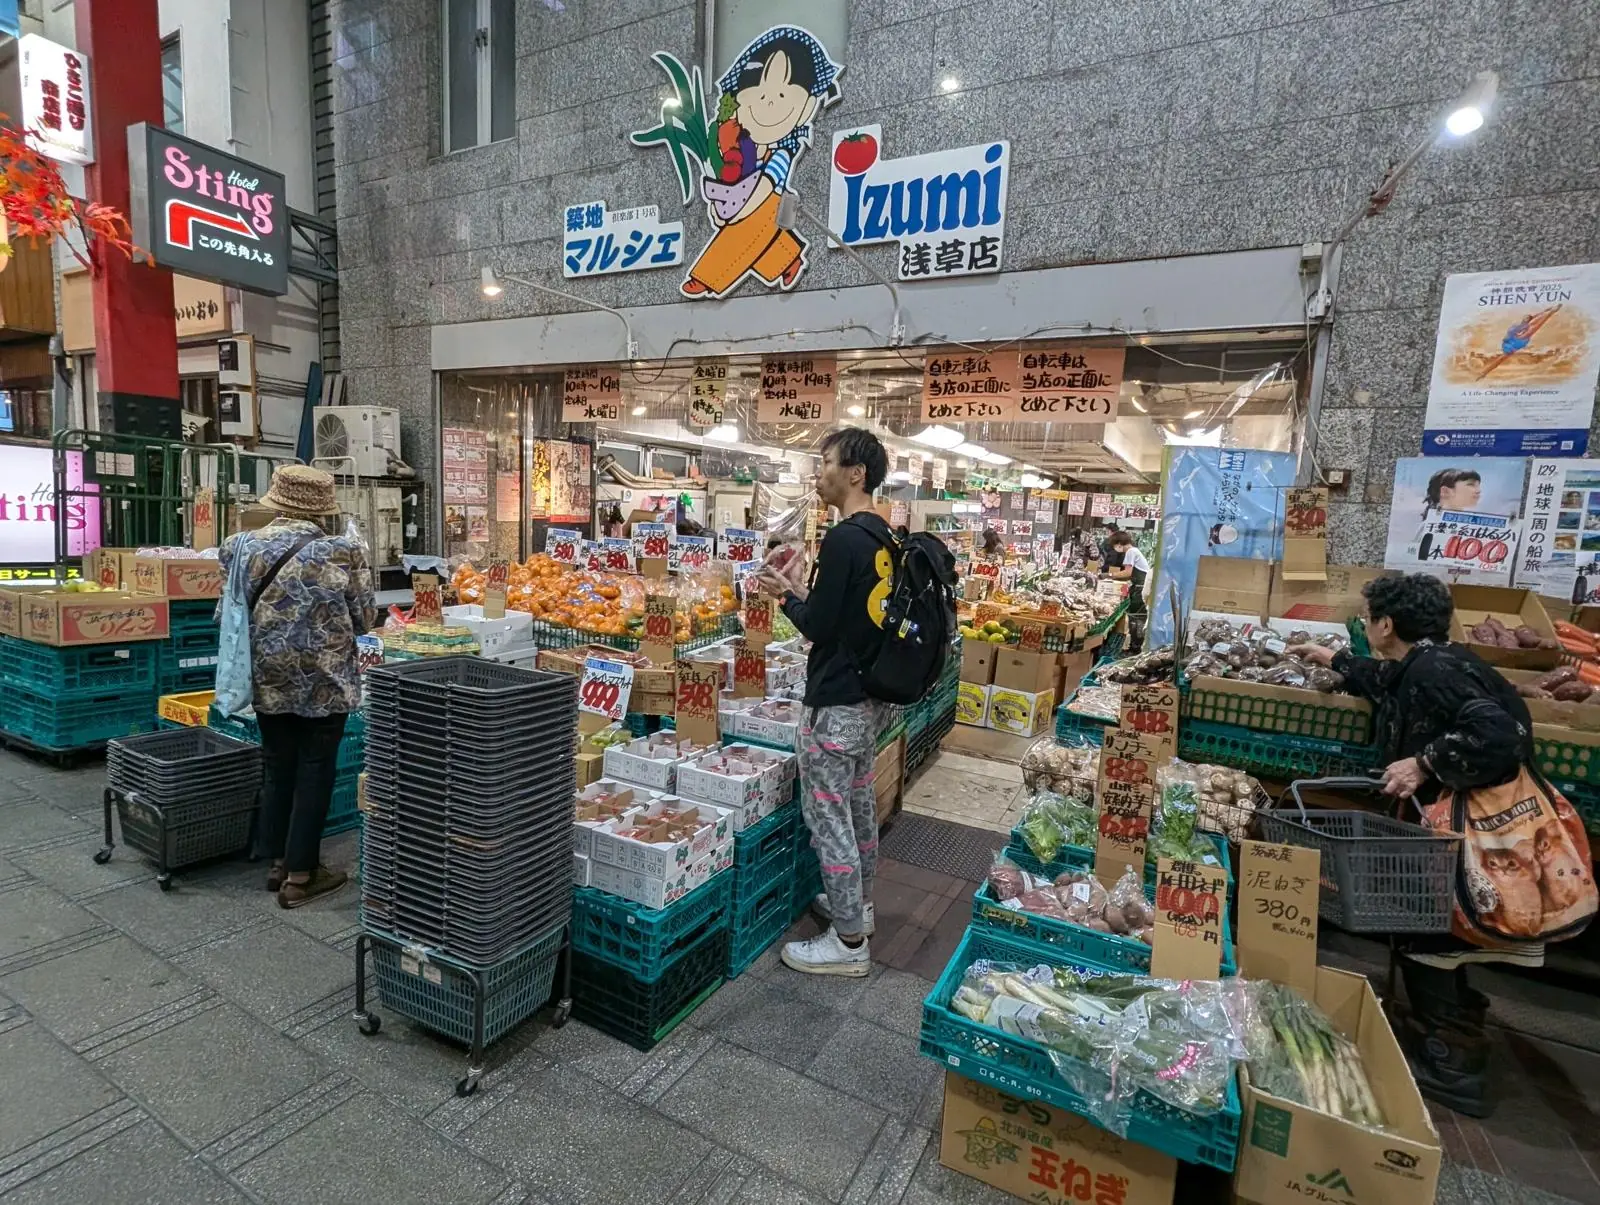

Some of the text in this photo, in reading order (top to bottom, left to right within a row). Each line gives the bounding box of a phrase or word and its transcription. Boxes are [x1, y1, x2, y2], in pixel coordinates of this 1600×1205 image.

[164, 146, 274, 234] Sting
[227, 170, 259, 191] Hotel
[842, 143, 1003, 243] Izumi
[567, 204, 603, 232] 築地
[199, 234, 274, 266] この先角入る
[566, 230, 681, 273] マルシェ
[901, 236, 1001, 276] 浅草店
[1478, 290, 1572, 306] SHEN YUN
[765, 361, 813, 374] 営業時間
[929, 358, 992, 376] 自転車は
[1023, 352, 1088, 370] 自転車は
[566, 368, 598, 380] 営業時間
[694, 366, 726, 379] 金曜日
[1022, 370, 1113, 389] 当店の正面に
[765, 389, 797, 400] 定休日
[929, 377, 1011, 396] 当店の正面に
[565, 395, 587, 406] 定休日
[779, 401, 821, 419] 水曜日
[928, 402, 1002, 418] とめて下さい
[1020, 396, 1111, 415] とめて下さい
[584, 404, 617, 419] 水曜日
[1537, 465, 1556, 476] 129
[31, 482, 81, 502] Hoel
[1458, 524, 1516, 542] 紅はるか
[1523, 483, 1554, 573] 地球一周の船旅
[1444, 535, 1508, 563] 100
[0, 569, 80, 579] 日サース
[582, 682, 620, 711] 999
[1247, 869, 1313, 895] 泥ねぎ
[1157, 884, 1219, 919] 100
[1254, 898, 1311, 927] 380 円
[1203, 930, 1218, 944] 円
[1028, 1146, 1129, 1205] 玉ねぎ
